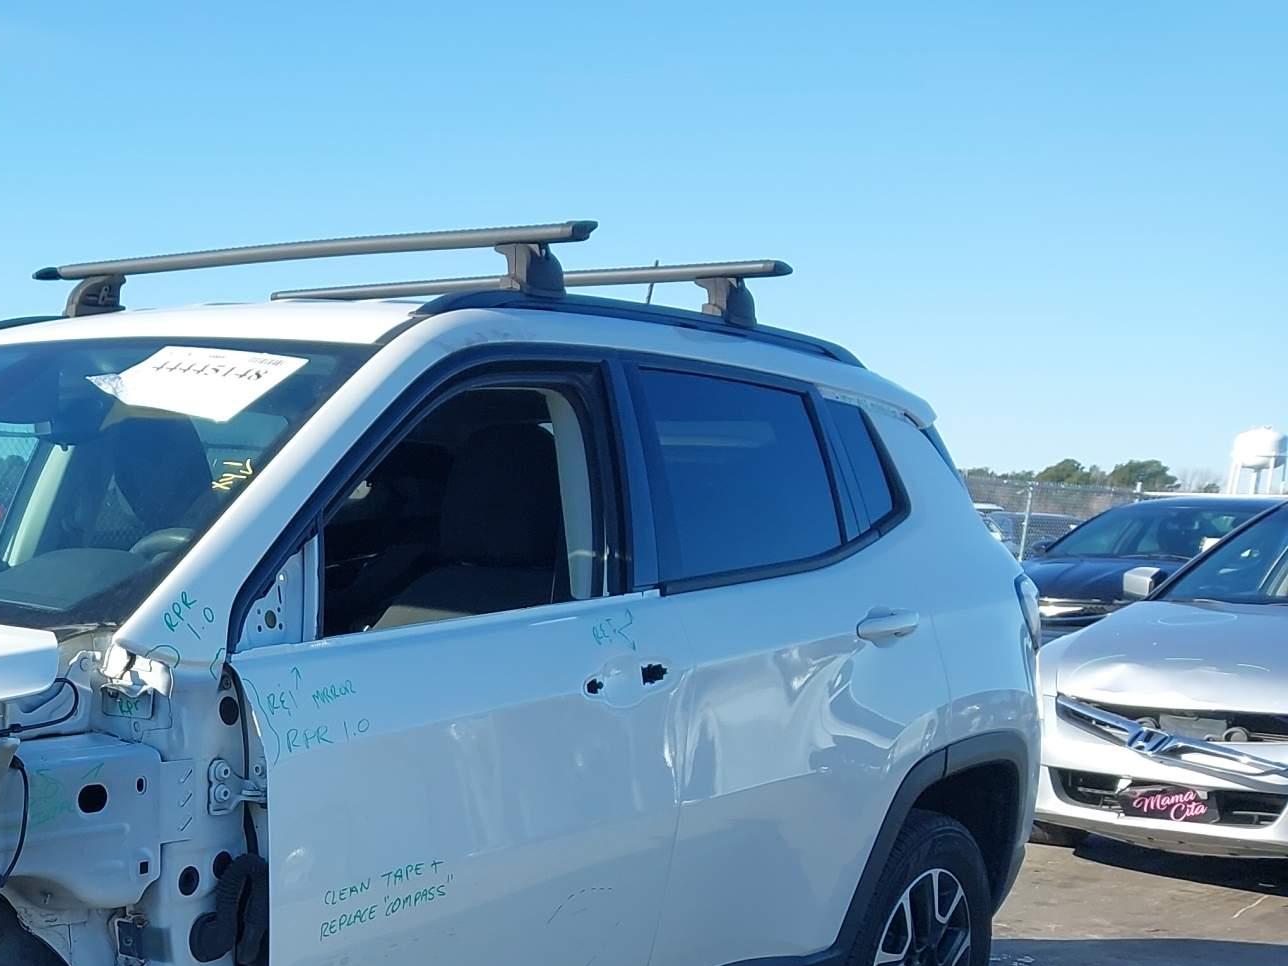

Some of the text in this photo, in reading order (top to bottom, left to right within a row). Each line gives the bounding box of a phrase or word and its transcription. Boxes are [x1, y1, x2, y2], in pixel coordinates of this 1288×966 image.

[151, 360, 269, 380] 44445148
[163, 591, 197, 632] RPR
[187, 607, 214, 640] 1.0
[343, 718, 370, 738] 1.0
[1132, 790, 1197, 812] Mama
[1170, 802, 1208, 821] Cita
[324, 877, 371, 905] CLEAN
[381, 862, 425, 887] TAPE
[319, 904, 379, 942] REPLACE
